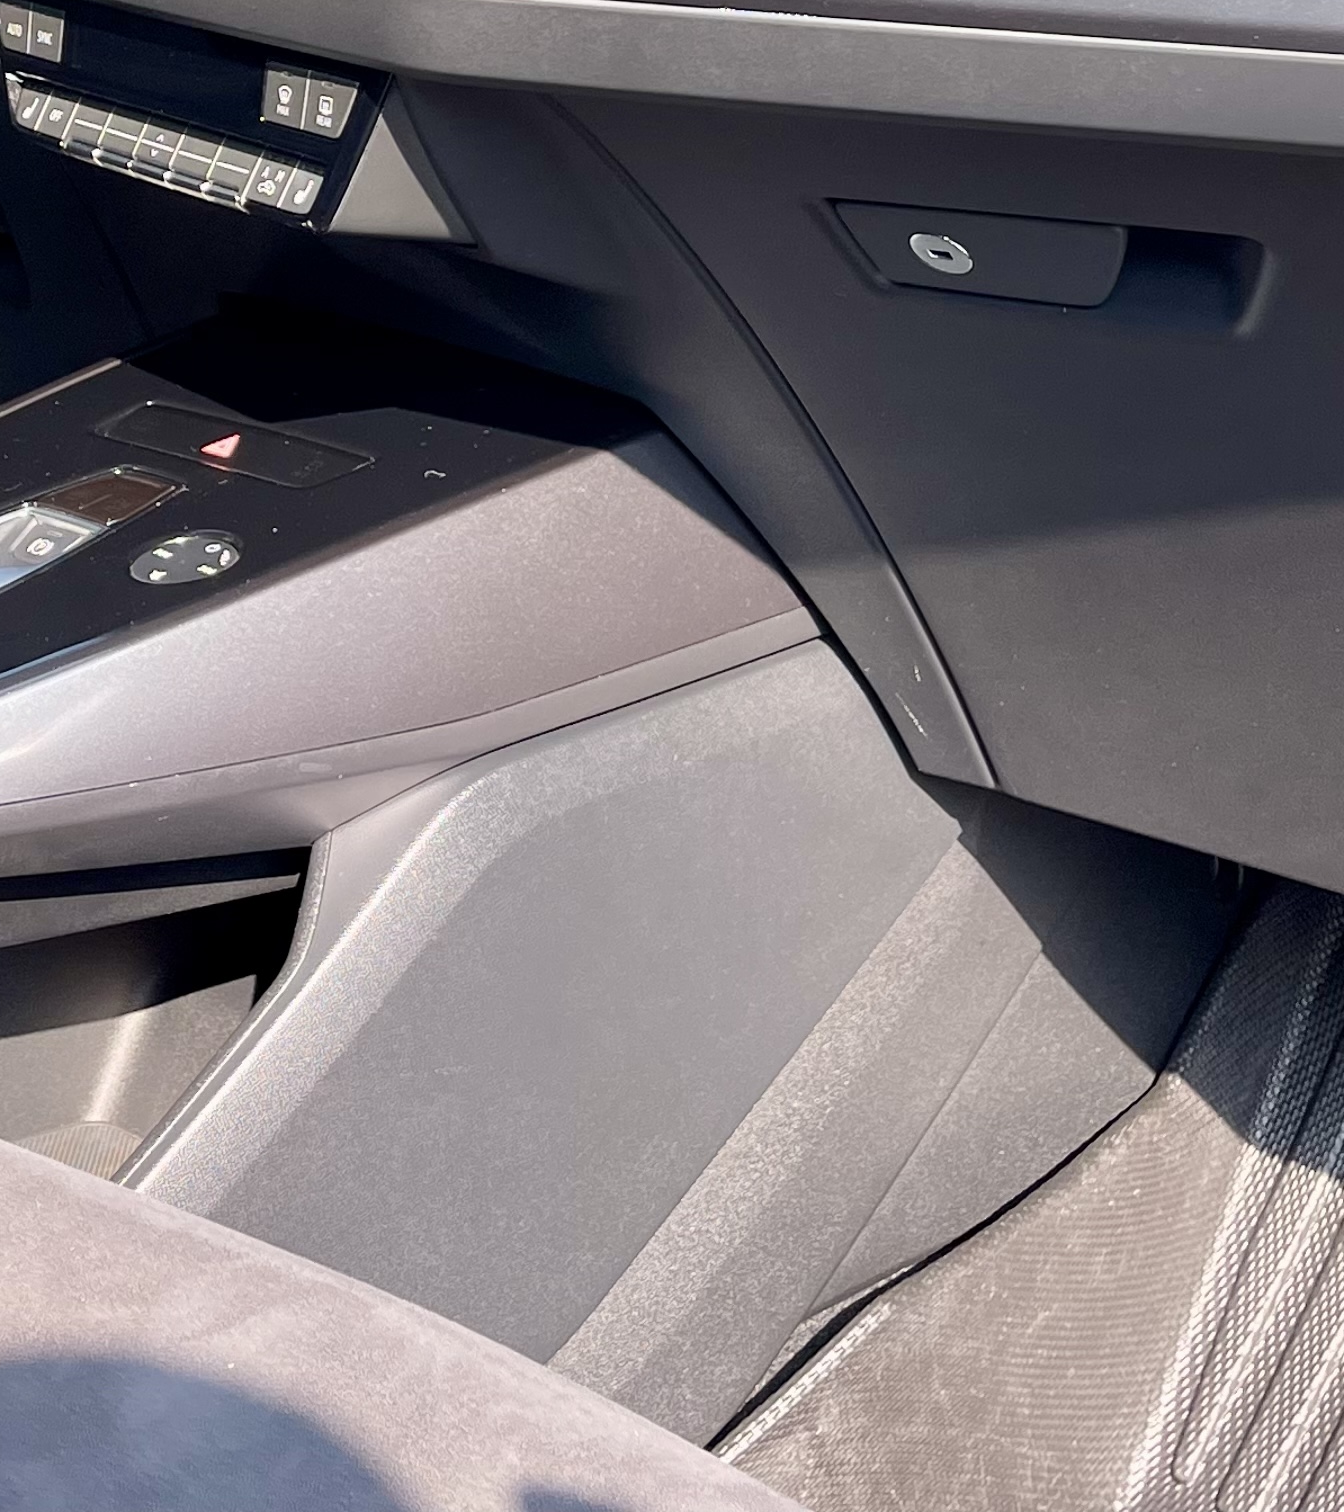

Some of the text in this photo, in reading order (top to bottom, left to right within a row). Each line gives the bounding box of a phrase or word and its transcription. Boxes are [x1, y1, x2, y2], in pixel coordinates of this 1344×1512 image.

[7, 22, 22, 37] AUTO
[37, 30, 52, 45] SYNC
[48, 108, 64, 122] OFF
